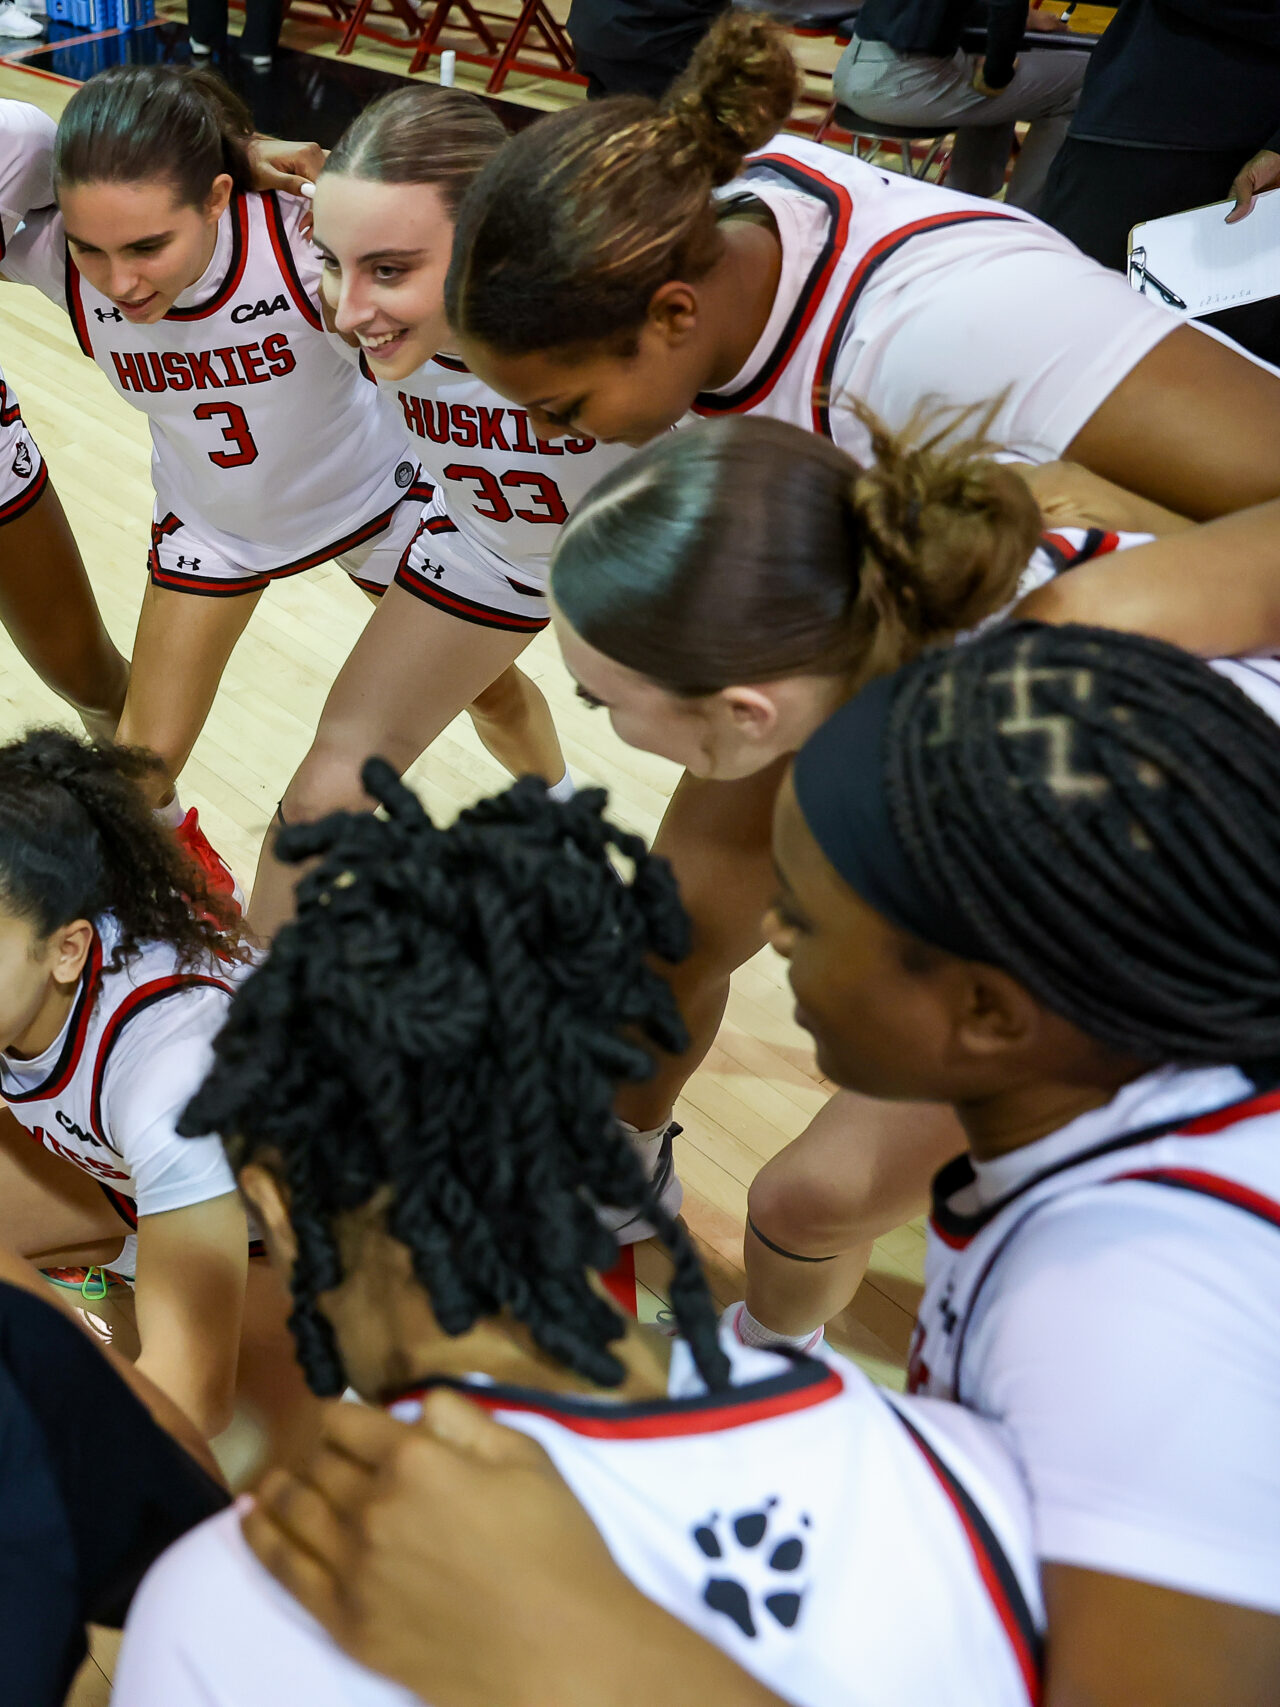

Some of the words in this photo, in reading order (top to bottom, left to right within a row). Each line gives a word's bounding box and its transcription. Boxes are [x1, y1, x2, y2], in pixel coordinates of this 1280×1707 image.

[231, 294, 290, 324] CAA
[110, 332, 297, 393] HUSKIES
[192, 401, 259, 468] 3
[398, 390, 596, 455] HUSKI
[443, 463, 569, 525] 33
